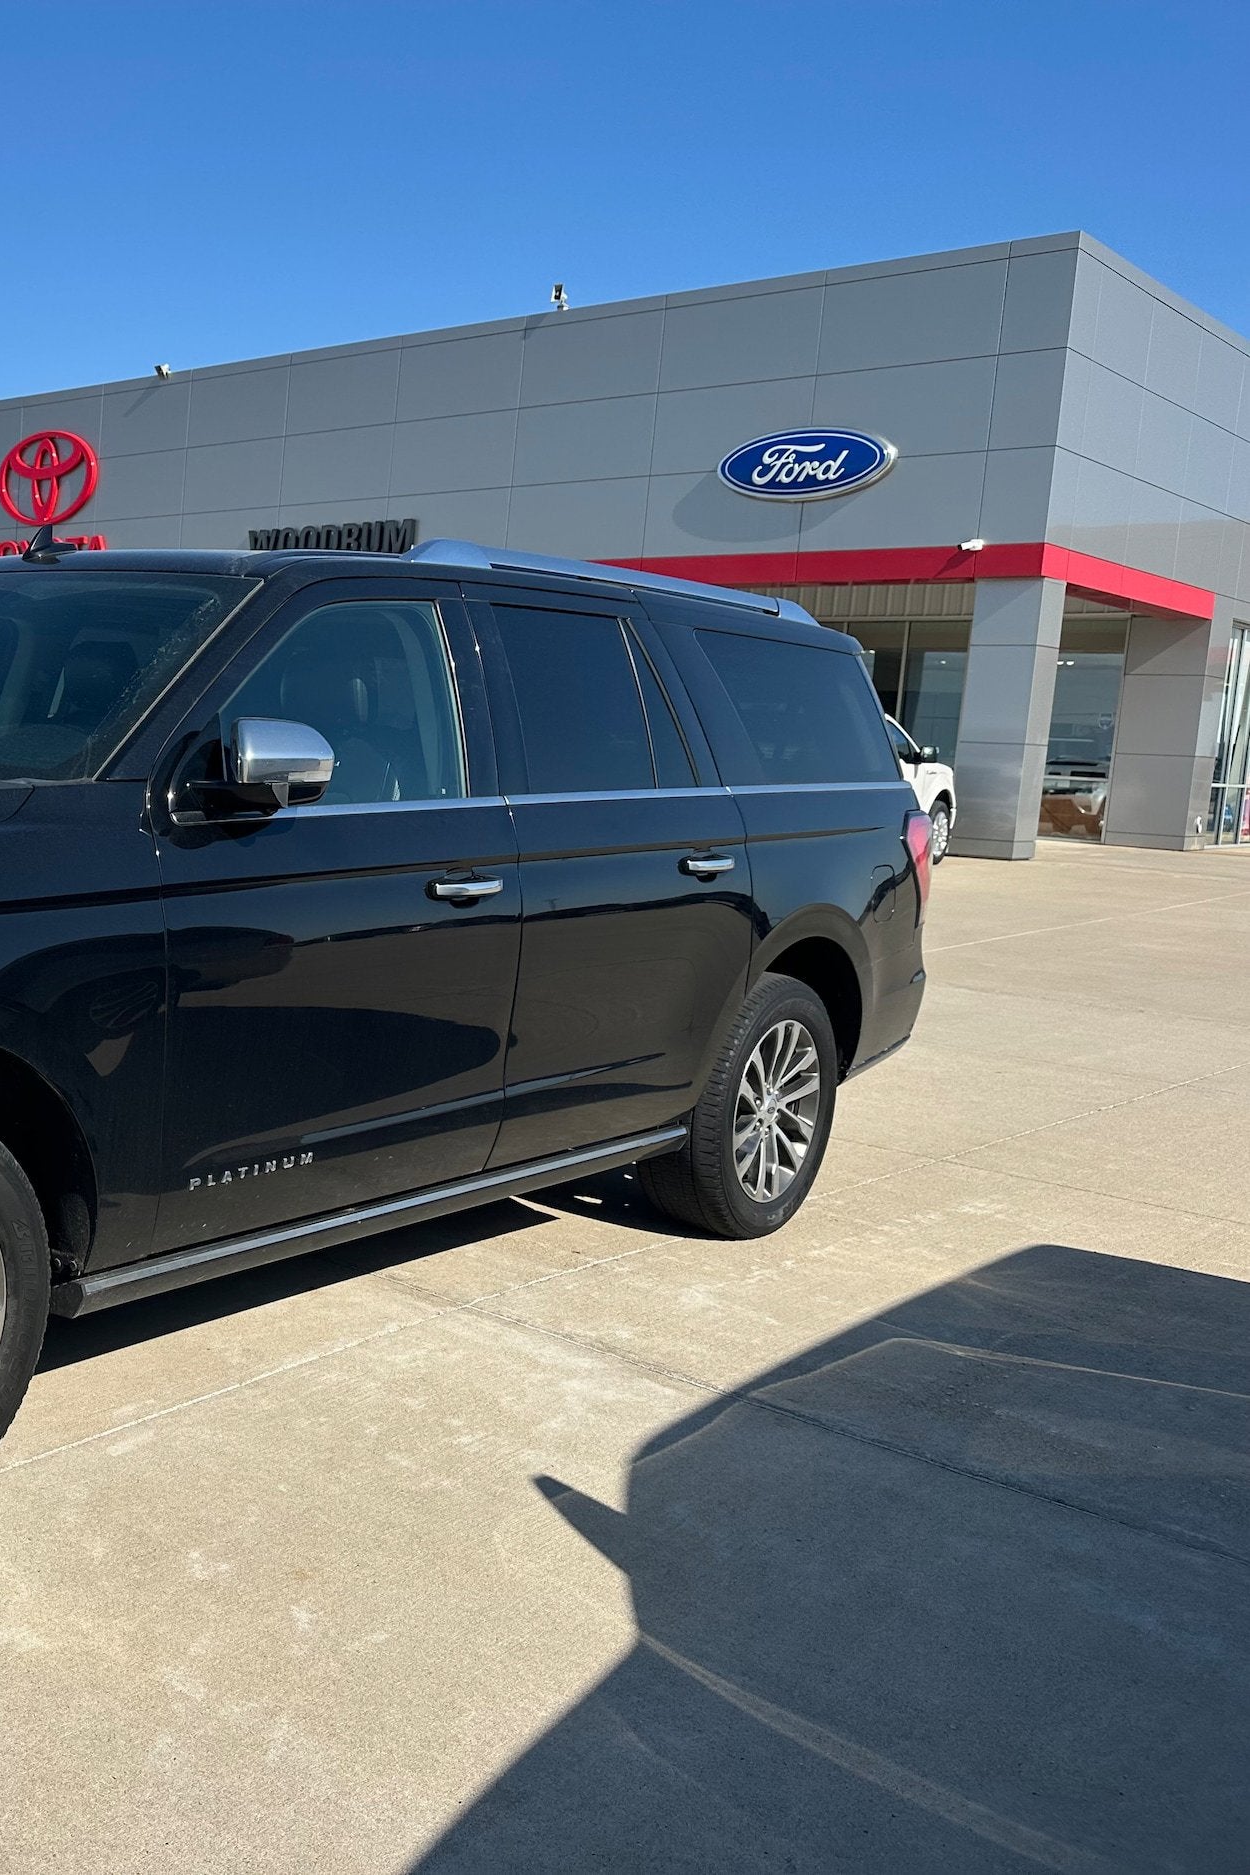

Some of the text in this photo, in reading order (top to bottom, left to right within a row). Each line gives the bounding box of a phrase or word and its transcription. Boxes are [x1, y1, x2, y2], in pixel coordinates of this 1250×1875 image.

[752, 443, 850, 486] Ford
[248, 518, 417, 554] WOODRUM
[189, 1151, 314, 1191] PLATINUM
